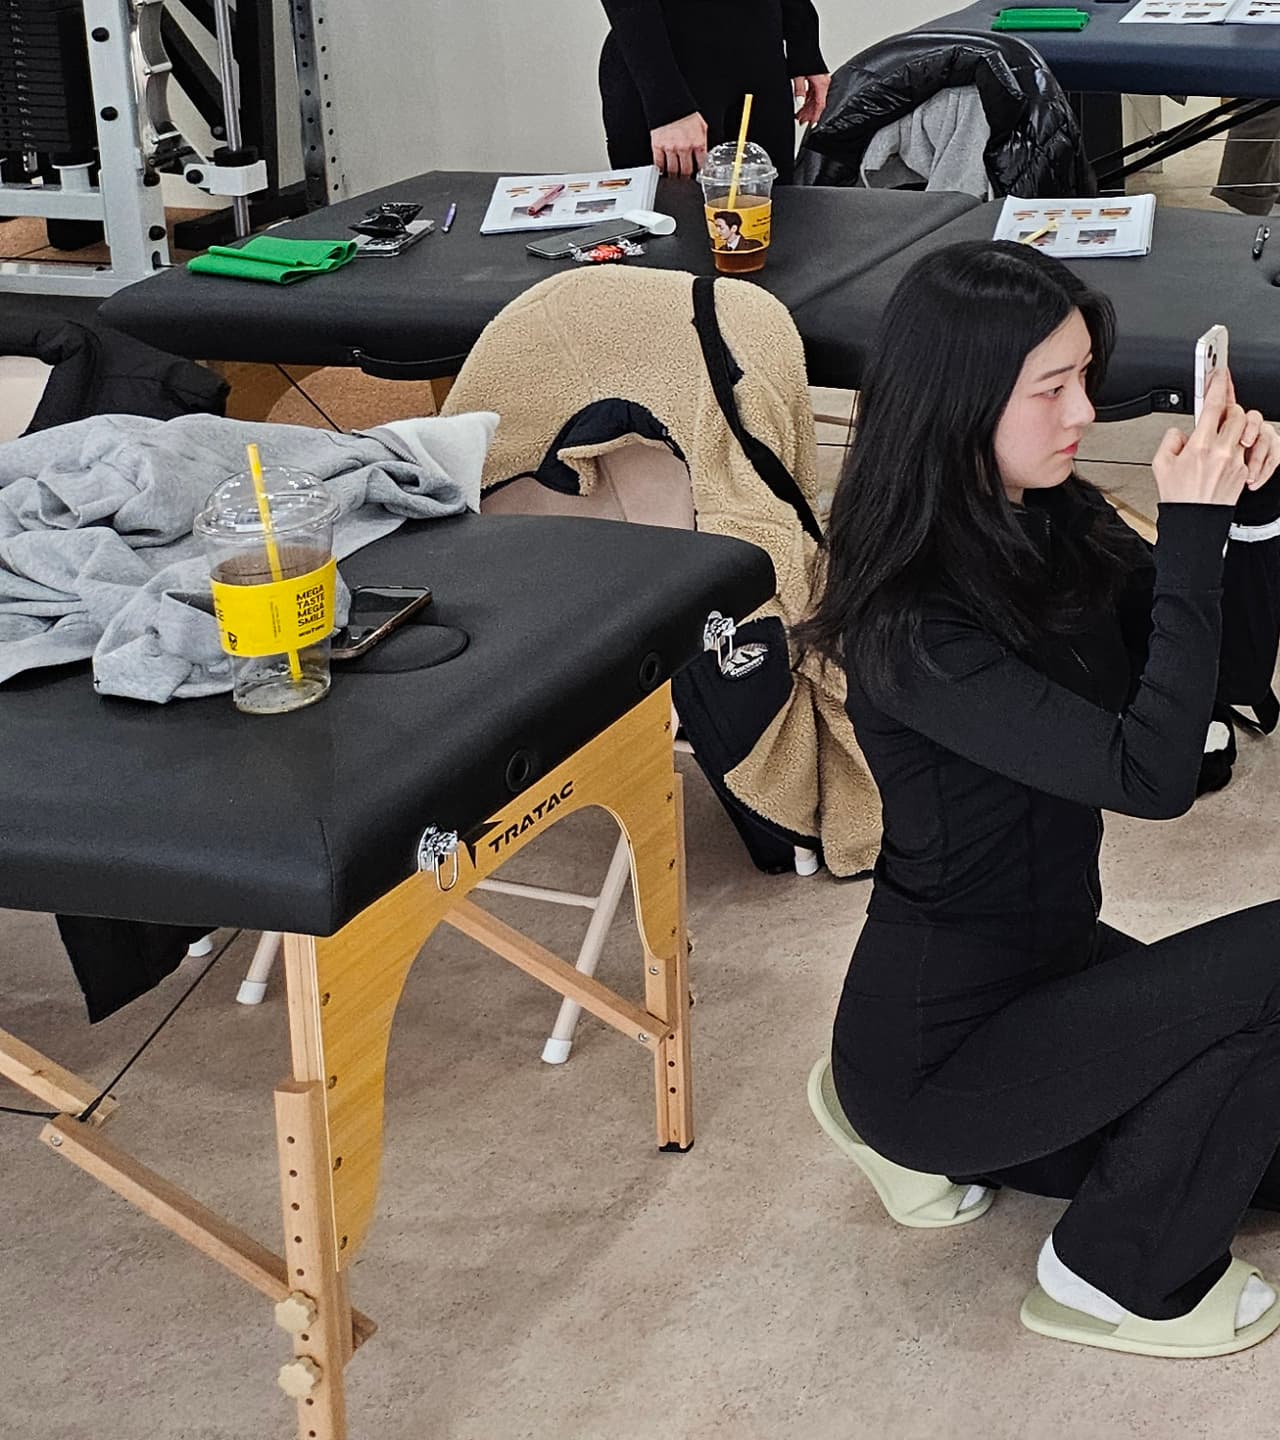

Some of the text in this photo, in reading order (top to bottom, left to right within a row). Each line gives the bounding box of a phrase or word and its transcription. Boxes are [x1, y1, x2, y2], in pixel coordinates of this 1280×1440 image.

[296, 584, 324, 601] MEGA
[297, 592, 325, 609] TASTE
[297, 602, 325, 619] MEGA
[297, 610, 325, 628] SMILE
[488, 781, 575, 853] TRATAC
